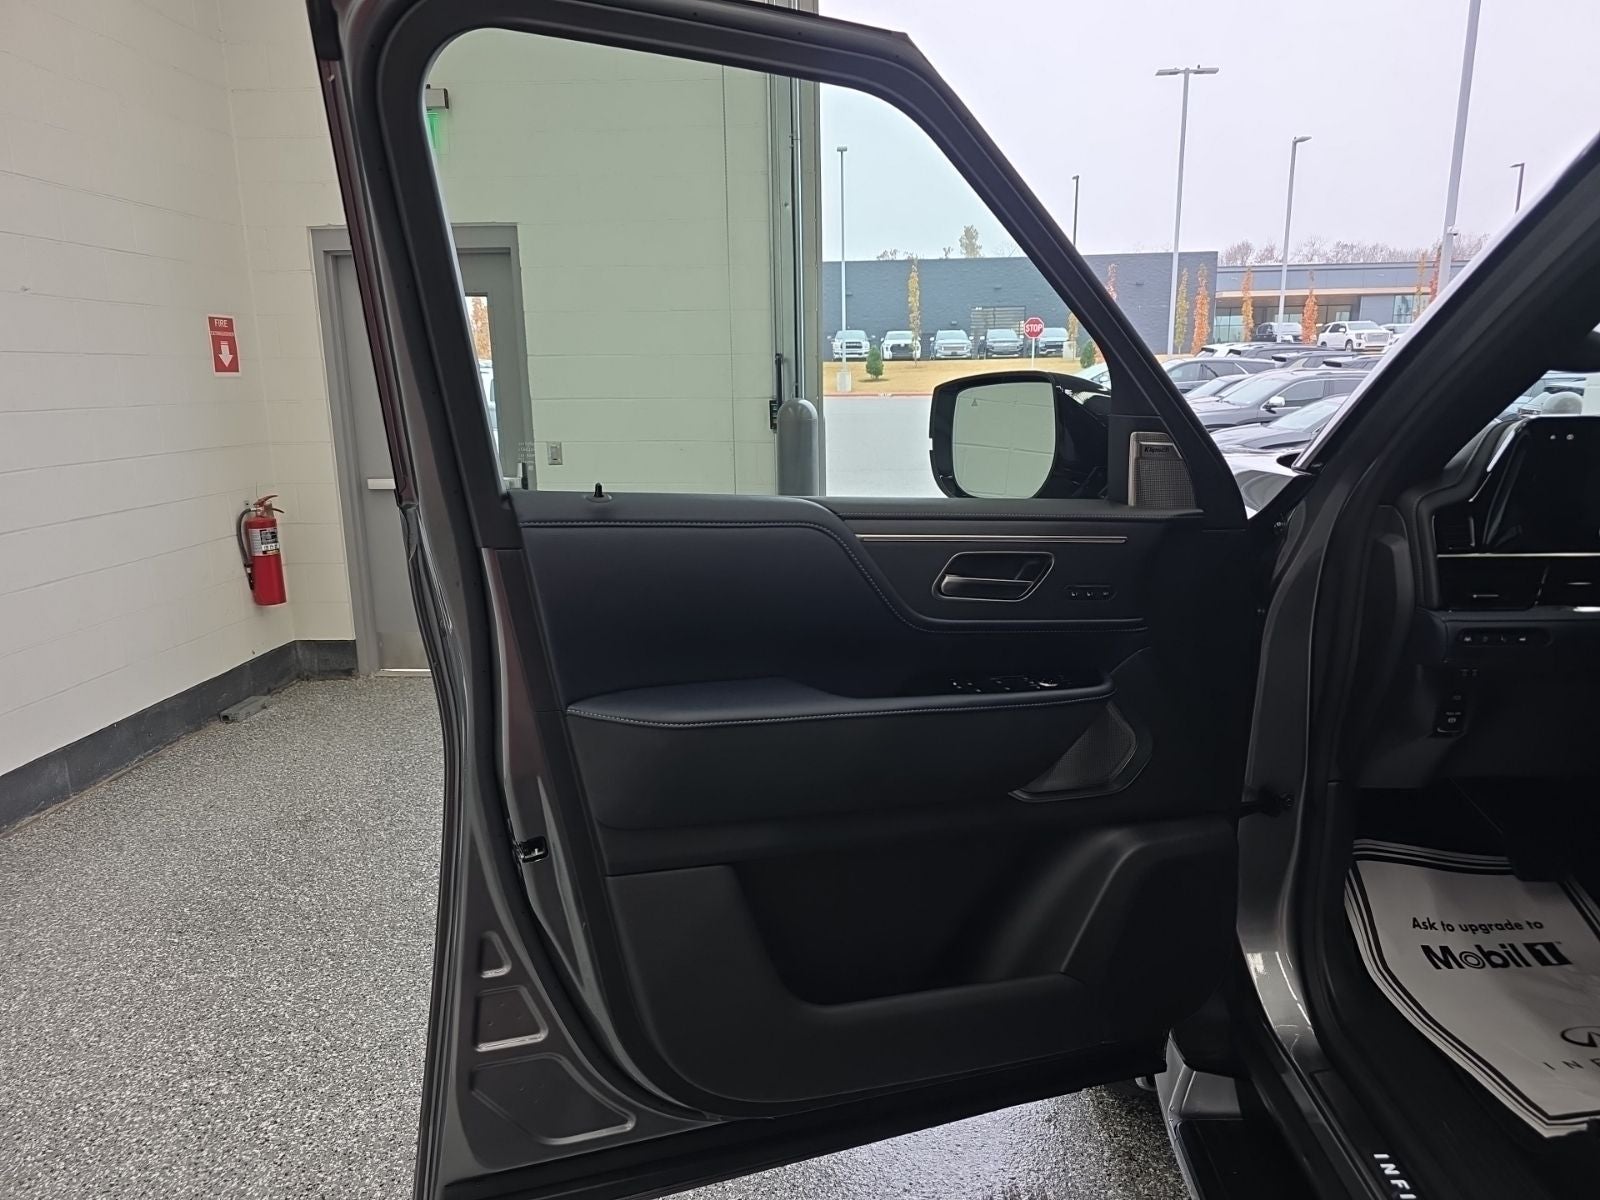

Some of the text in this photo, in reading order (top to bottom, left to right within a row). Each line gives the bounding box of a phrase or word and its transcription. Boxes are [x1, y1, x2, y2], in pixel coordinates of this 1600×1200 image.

[214, 318, 229, 328] FIRE
[1025, 323, 1043, 333] STOP
[1412, 917, 1544, 934] Ask to upgrade to
[1421, 942, 1567, 970] Mobil 1
